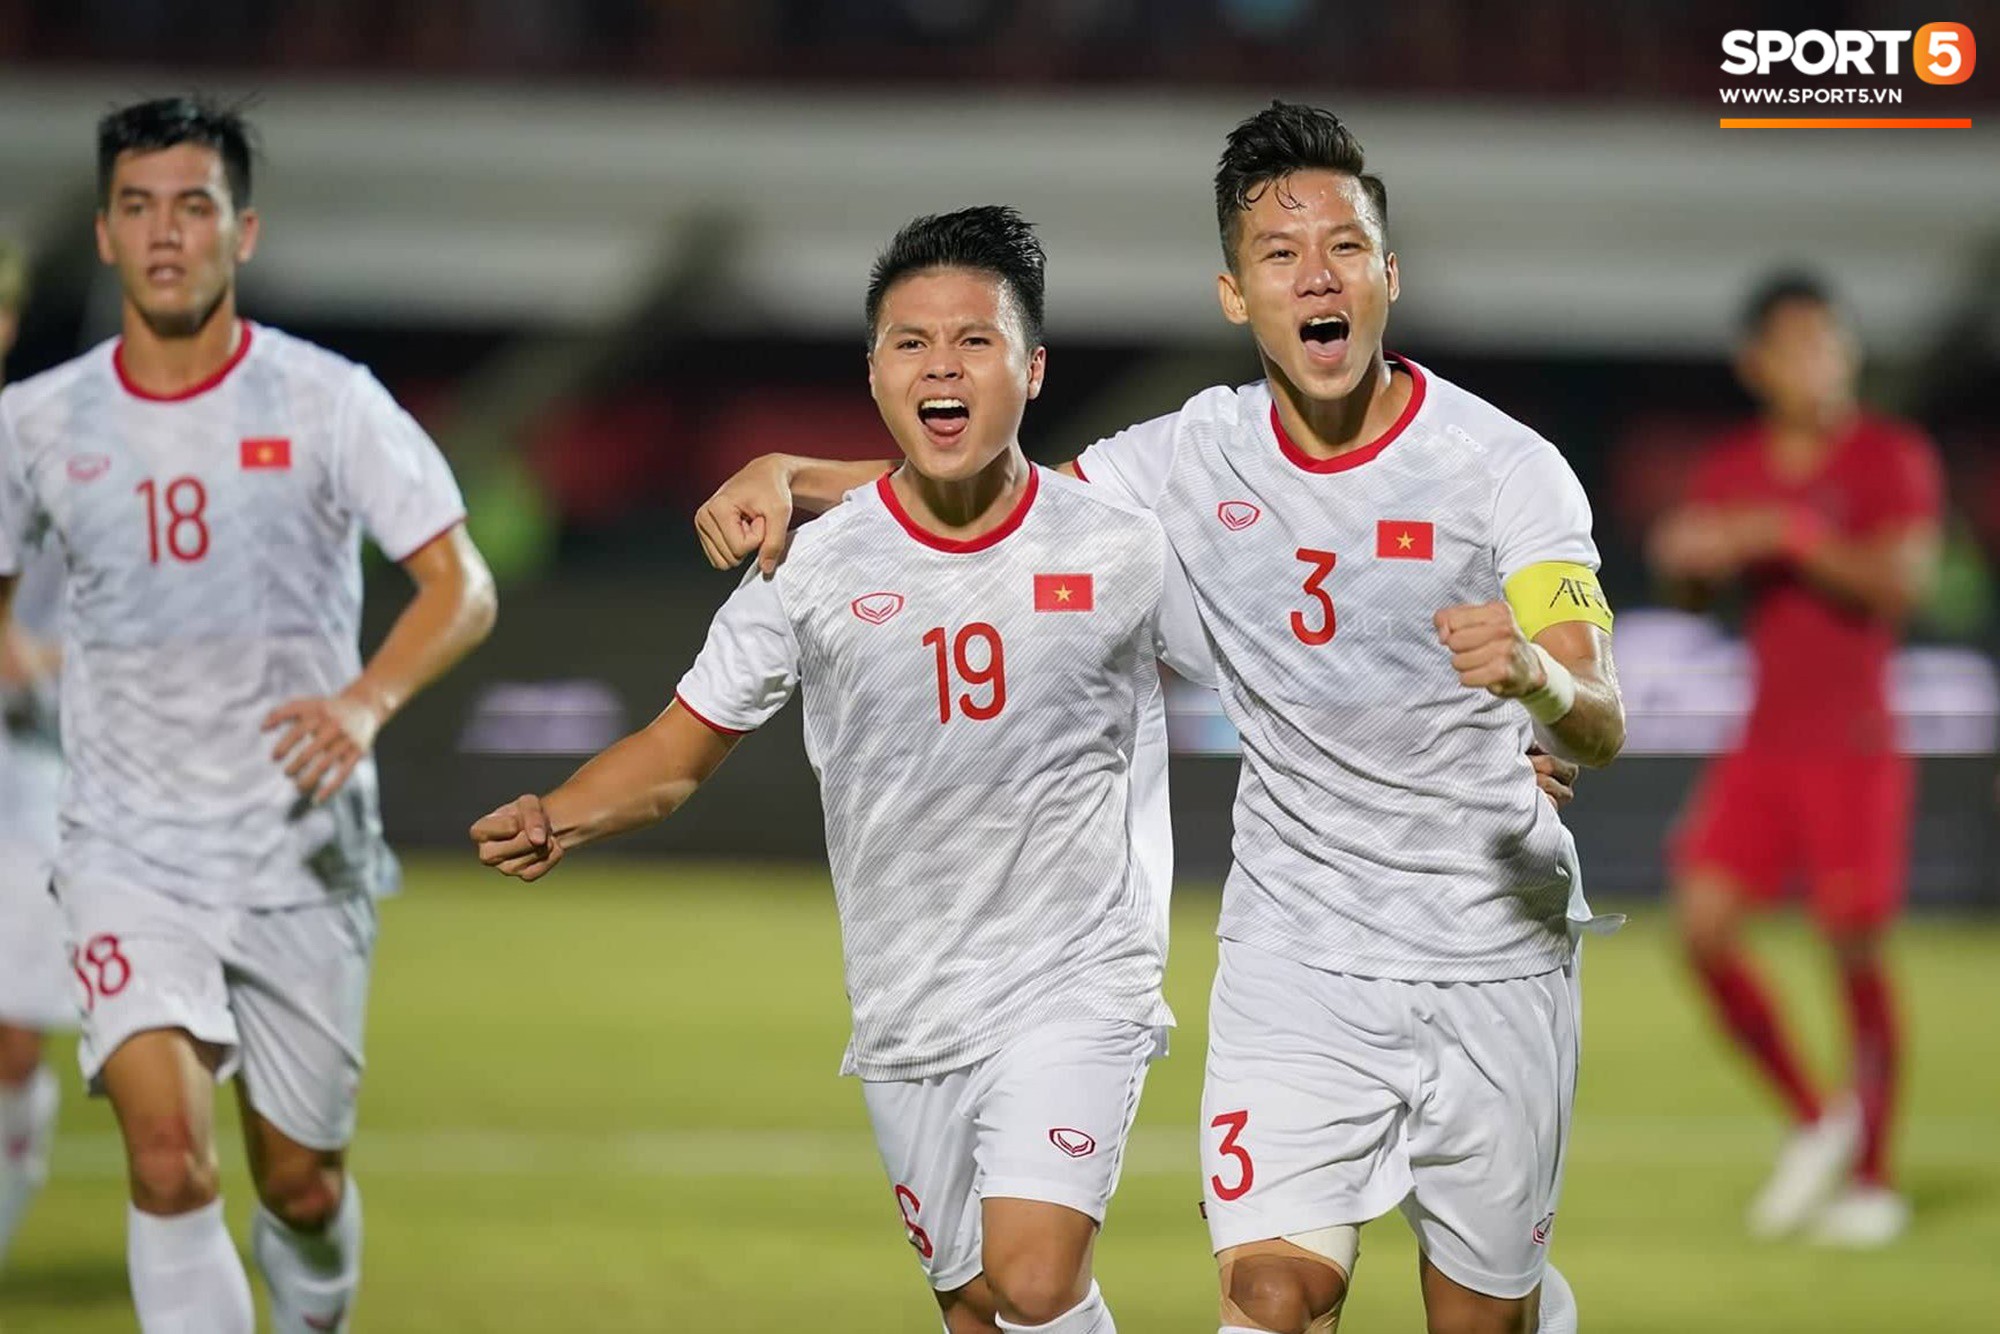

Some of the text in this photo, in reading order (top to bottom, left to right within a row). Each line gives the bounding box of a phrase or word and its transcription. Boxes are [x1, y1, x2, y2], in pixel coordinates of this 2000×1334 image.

[136, 475, 209, 566] 18
[1290, 547, 1337, 646] 3
[922, 622, 1006, 724] 19
[1210, 1109, 1254, 1201] 3
